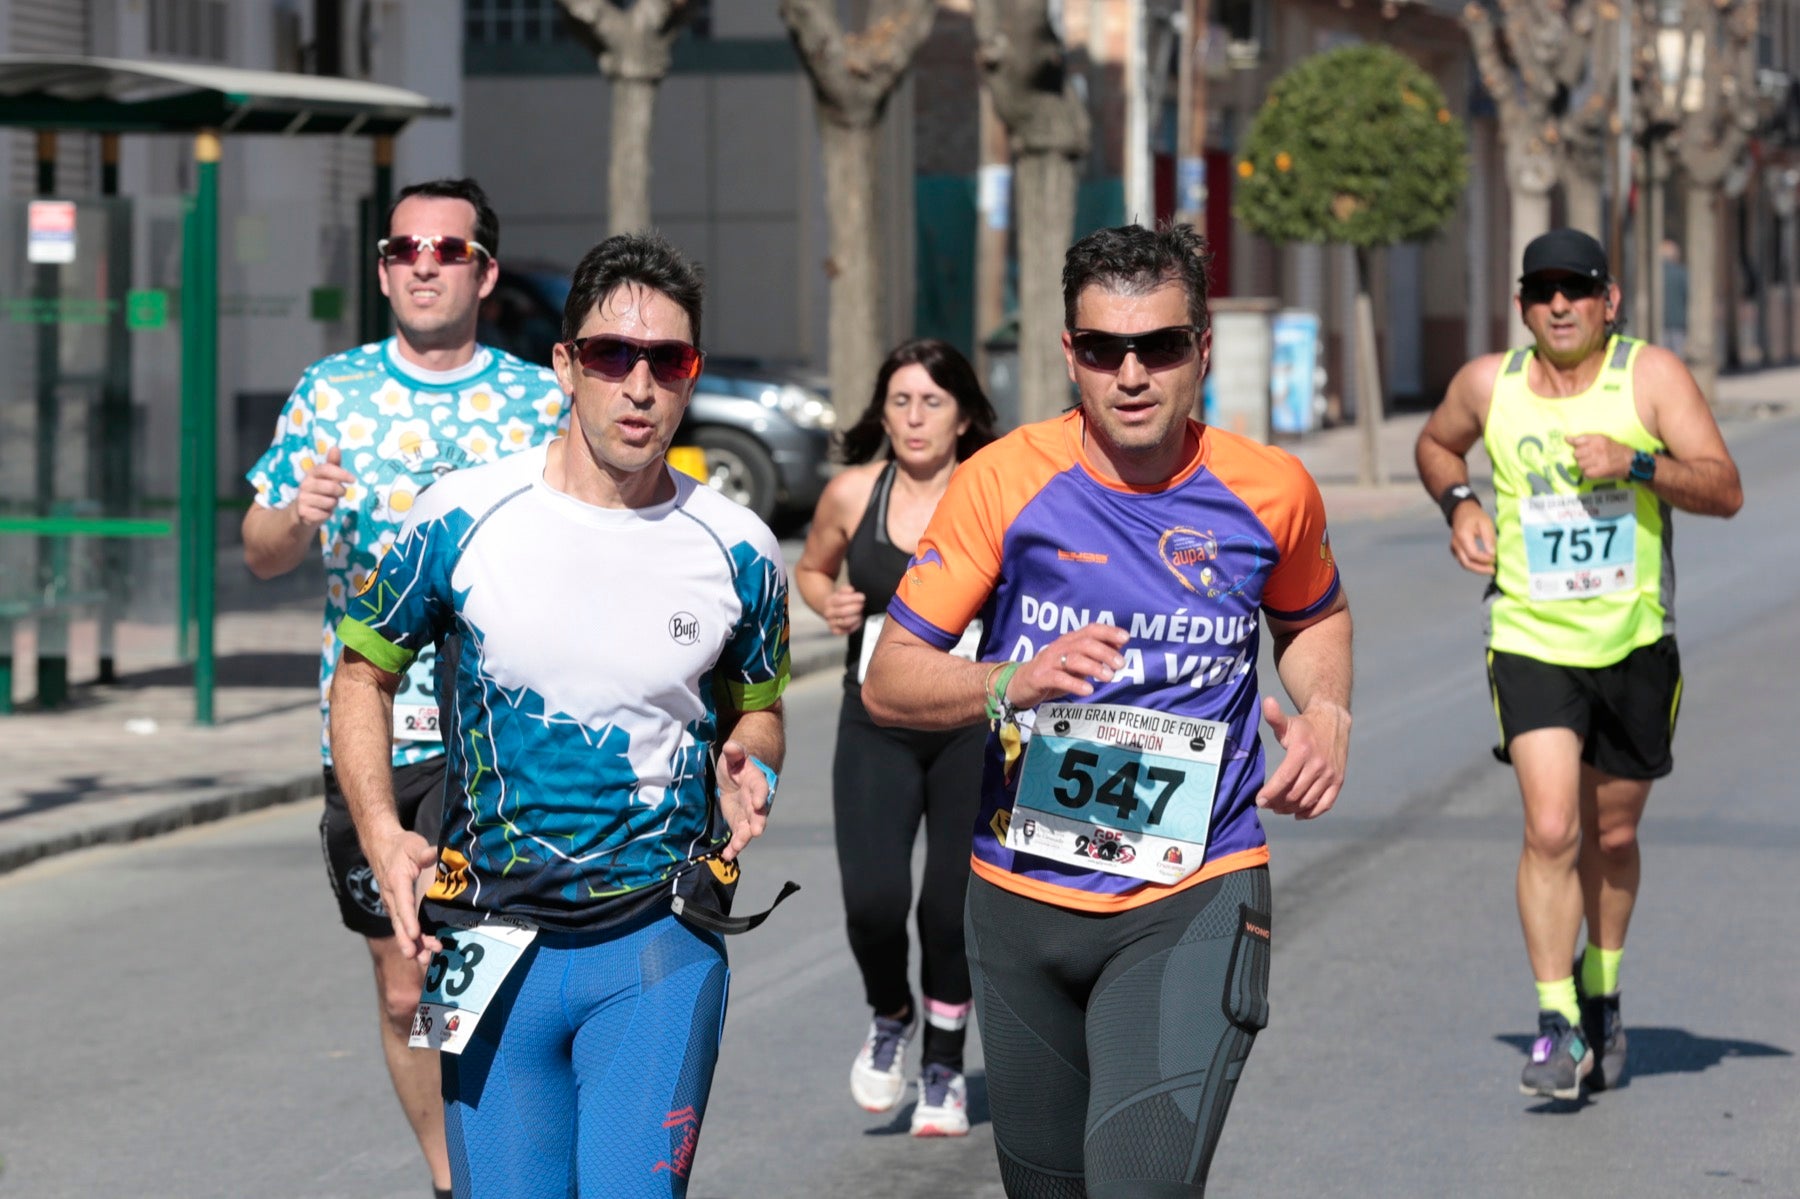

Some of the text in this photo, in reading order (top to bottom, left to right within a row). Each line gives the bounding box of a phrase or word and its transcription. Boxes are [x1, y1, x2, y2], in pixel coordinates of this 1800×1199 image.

[1172, 547, 1206, 567] aupa
[1542, 524, 1618, 565] 757
[1164, 648, 1252, 689] VIDA
[1050, 707, 1215, 741] XXXIII GRAN PREMIO DE FONDO
[1096, 725, 1164, 751] DIPUTACIÓN
[1053, 748, 1186, 826] 547
